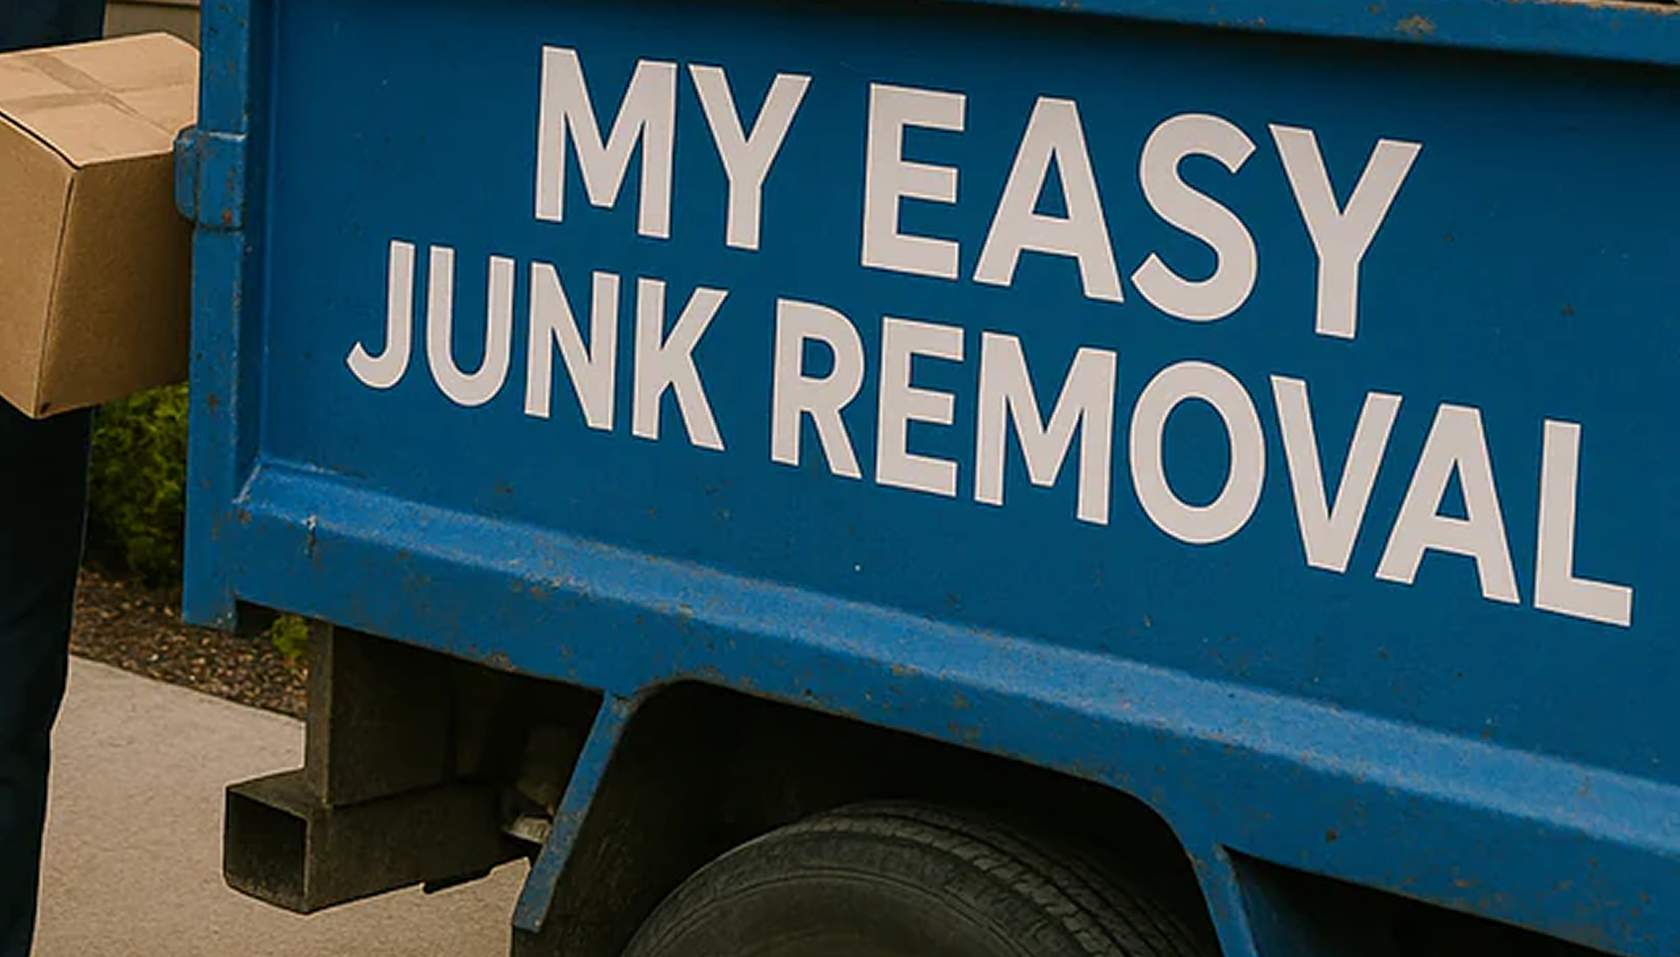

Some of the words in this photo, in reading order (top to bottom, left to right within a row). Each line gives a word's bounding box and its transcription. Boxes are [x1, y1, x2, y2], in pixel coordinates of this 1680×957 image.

[534, 45, 812, 250] MY
[861, 83, 1422, 339] EASY
[346, 240, 728, 451] JUNK
[771, 298, 1633, 627] REMOVAL
